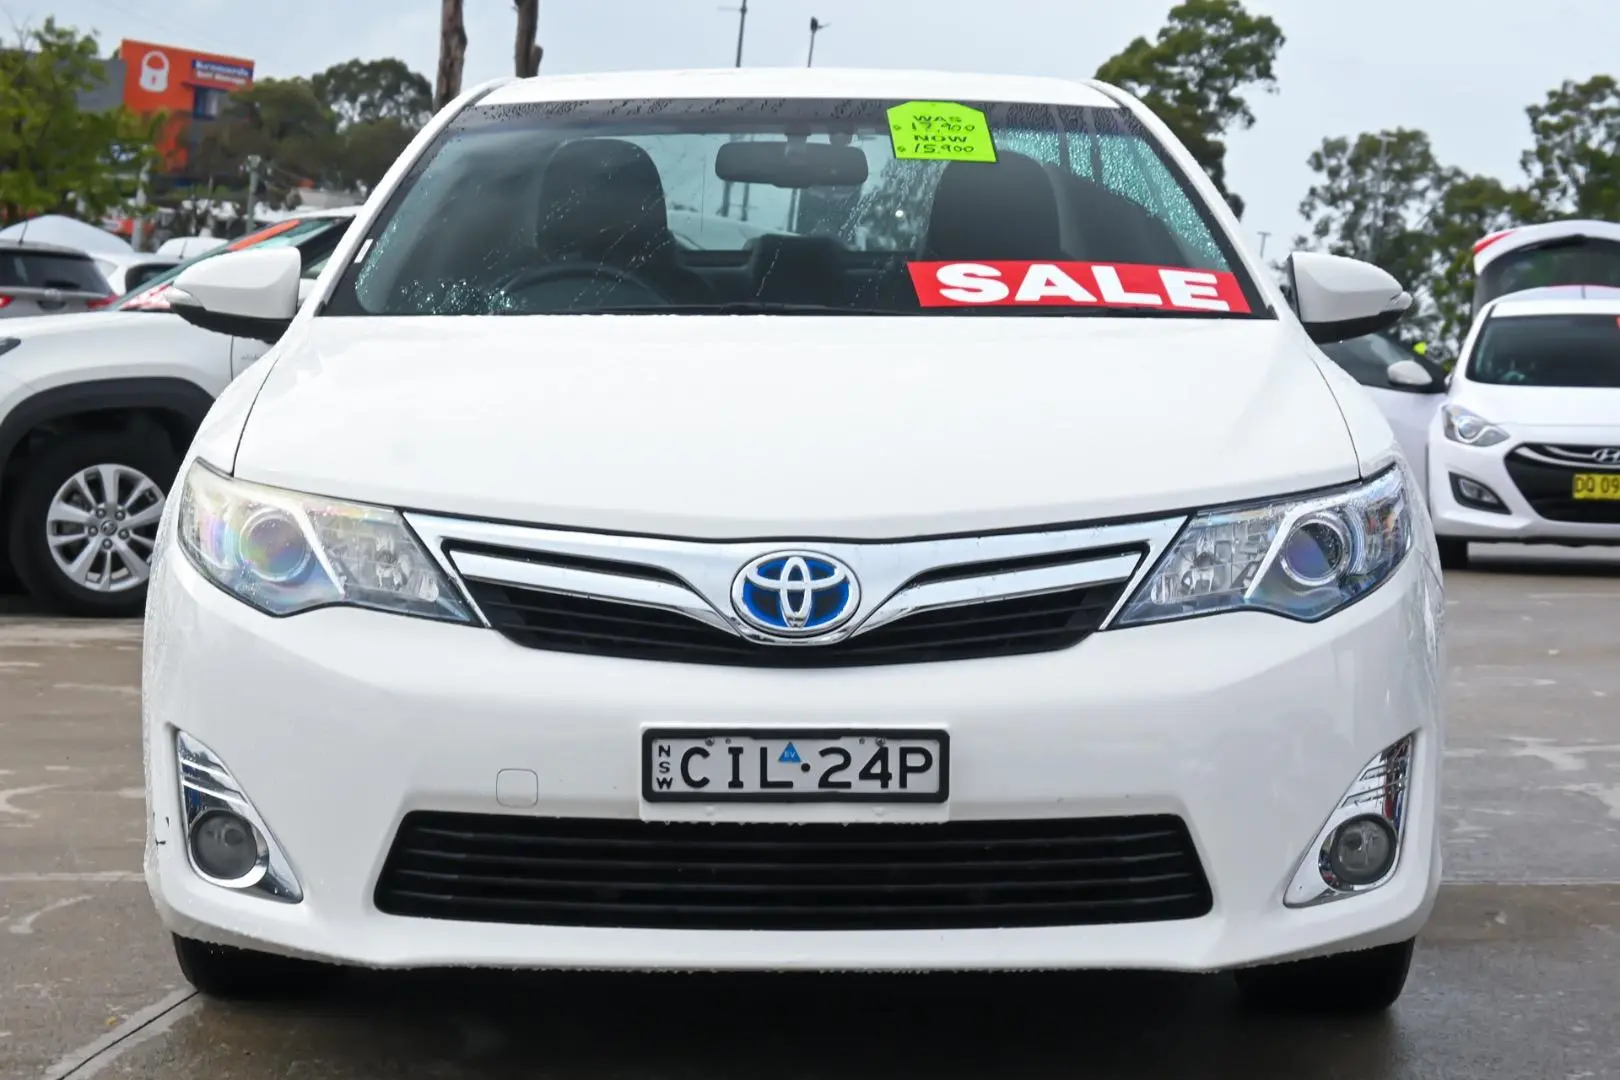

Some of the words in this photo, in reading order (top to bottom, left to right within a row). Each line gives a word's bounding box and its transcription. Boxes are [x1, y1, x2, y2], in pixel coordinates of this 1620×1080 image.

[913, 115, 962, 123] WAS
[914, 135, 968, 143] NOW
[936, 263, 1230, 311] SALE
[656, 745, 673, 789] NSW
